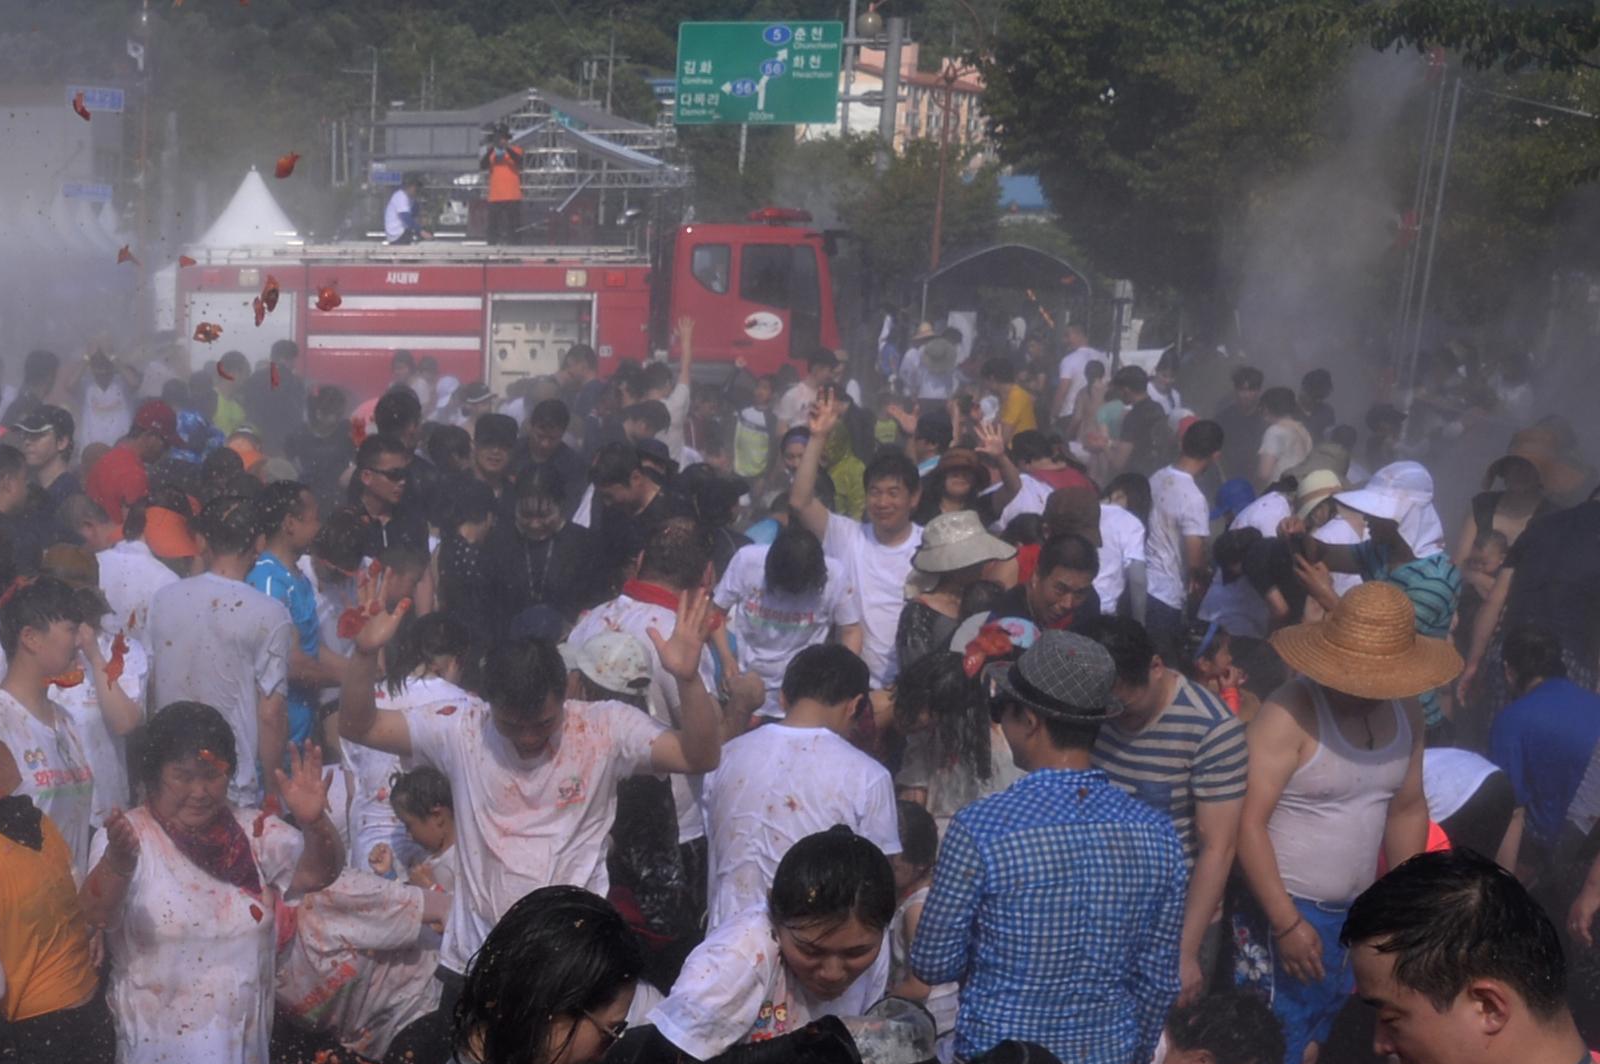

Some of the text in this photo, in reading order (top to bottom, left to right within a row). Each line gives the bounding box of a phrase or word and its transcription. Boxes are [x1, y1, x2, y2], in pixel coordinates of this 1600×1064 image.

[773, 30, 782, 41] 5
[683, 60, 713, 75] 김화
[792, 55, 822, 69] 화천
[736, 81, 753, 95] 56
[680, 93, 720, 107] 다목리
[748, 112, 775, 121] 200m
